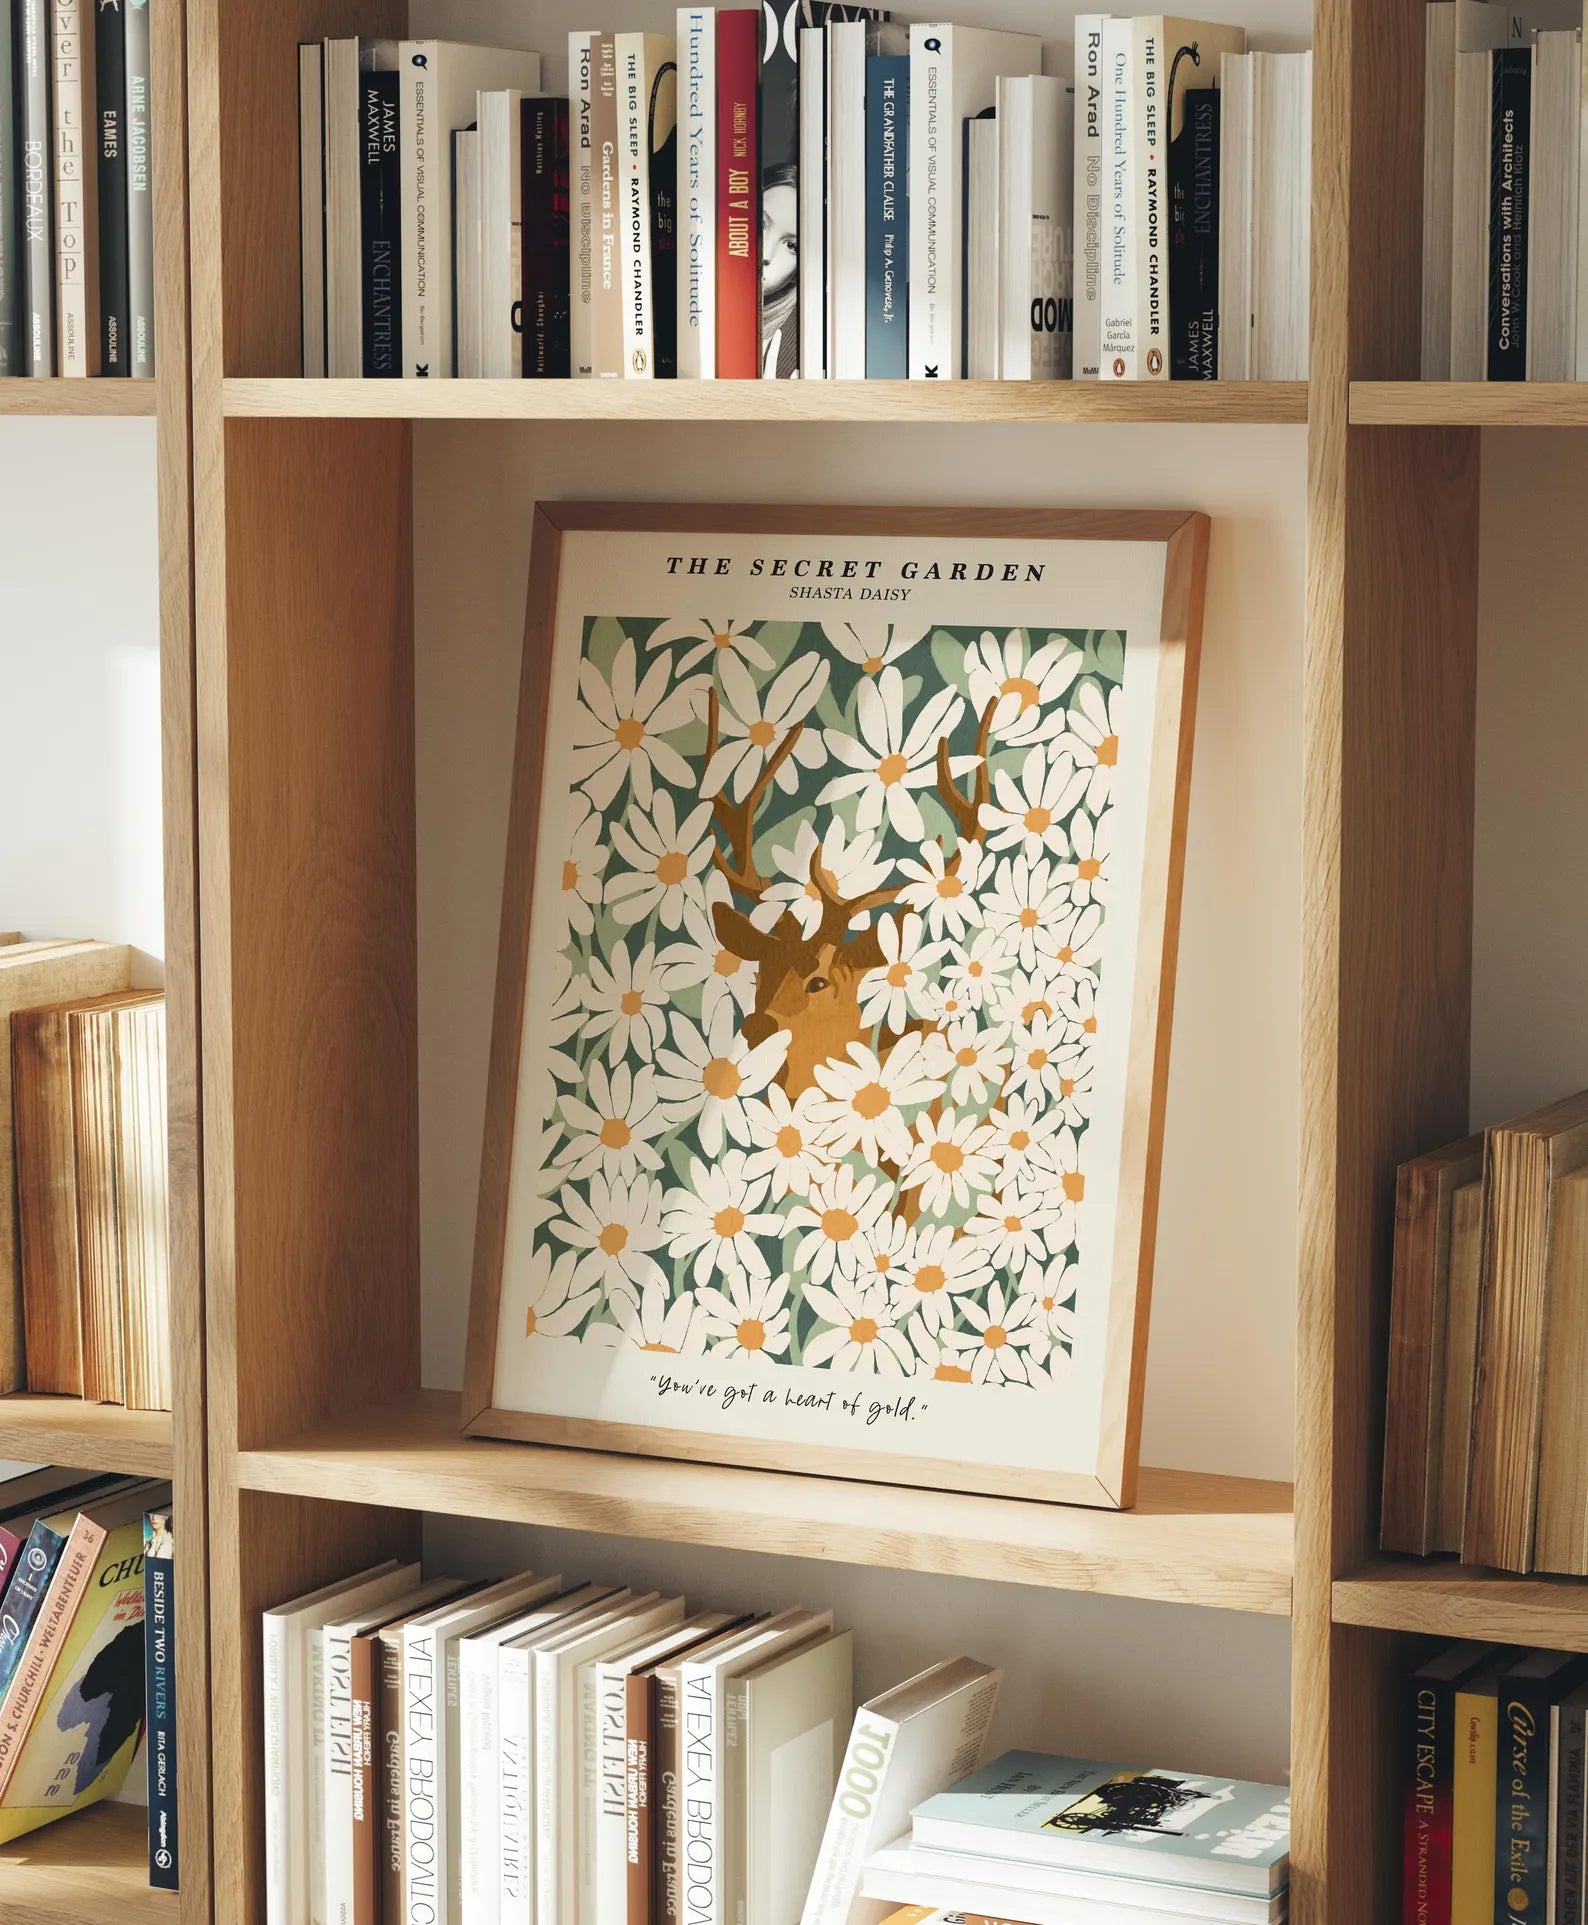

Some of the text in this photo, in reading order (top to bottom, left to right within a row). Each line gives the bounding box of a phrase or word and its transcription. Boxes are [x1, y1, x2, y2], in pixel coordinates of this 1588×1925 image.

[382, 100, 396, 153] JAMES
[927, 66, 937, 135] ESSENTIALS
[103, 110, 118, 158] EAMES
[131, 75, 147, 192] ARNE JACOBSEN
[367, 89, 380, 165] MAXWELL
[928, 136, 937, 153] OF
[579, 48, 592, 304] Ron Arad No Discipline
[689, 14, 704, 328] Hundred Years of Solitude
[728, 101, 749, 258] ABOUT A BOY NICK HORNBY
[927, 154, 937, 194] VISUAL
[1084, 32, 1100, 302] Ron Arad No Discipline
[1113, 52, 1127, 285] One Hundred Years of Solitude
[1194, 103, 1213, 233] ENCHANTRESS
[1513, 144, 1524, 175] Klotz
[24, 140, 44, 242] BORDEAUX
[61, 109, 78, 280] the Top
[415, 81, 426, 297] ESSENTIALS OF VISUAL COMMUNICATION
[627, 53, 644, 336] THE BIG SLEEP RAYMOND CHANDLER
[657, 189, 671, 208] the
[883, 78, 895, 324] THE GRANDFATHER CLAUSE Philip A. Genovese, Jr.
[1145, 37, 1160, 336] THE BIG SLEEP RAYMOND CHANDLER
[1512, 178, 1524, 230] Heinrich
[602, 141, 614, 290] Gardens in France
[657, 215, 672, 234] big
[1499, 108, 1514, 350] Conversations with Architects
[927, 196, 937, 294] COMMUNICATION
[1512, 233, 1522, 261] and
[372, 240, 392, 370] ENCHANTRESS
[1511, 263, 1522, 297] Cook
[32, 311, 42, 361] ASSOULINE
[67, 312, 76, 360] ASSOULINE
[108, 315, 118, 364] ASSOULINE
[136, 315, 146, 364] ASSOULINE
[1103, 343, 1135, 354] Márquez
[1105, 318, 1132, 327] Gabriel
[1106, 331, 1131, 340] García
[1188, 320, 1200, 372] JAMES
[1201, 308, 1214, 381] MAXWELL
[1510, 317, 1521, 349] John
[666, 556, 1047, 582] THE SECRET GARDEN
[788, 585, 912, 601] SHASTA DAISY
[721, 1383, 758, 1409] got
[762, 1389, 778, 1403] a
[785, 1387, 837, 1411] heart
[842, 1391, 863, 1416] of
[82, 1530, 95, 1545] 36
[7, 1551, 87, 1733] S. CHURCHILL WELTABENTEUER
[153, 1571, 167, 1797] BESIDE TWO RIVERS RITA GERLACH
[1417, 1689, 1436, 1740] CITY
[1416, 1743, 1435, 1815] ESCAPE
[1507, 1701, 1536, 1883] Curse of the Exile
[158, 1810, 168, 1848] Abingdon
[1418, 1820, 1429, 1831] A
